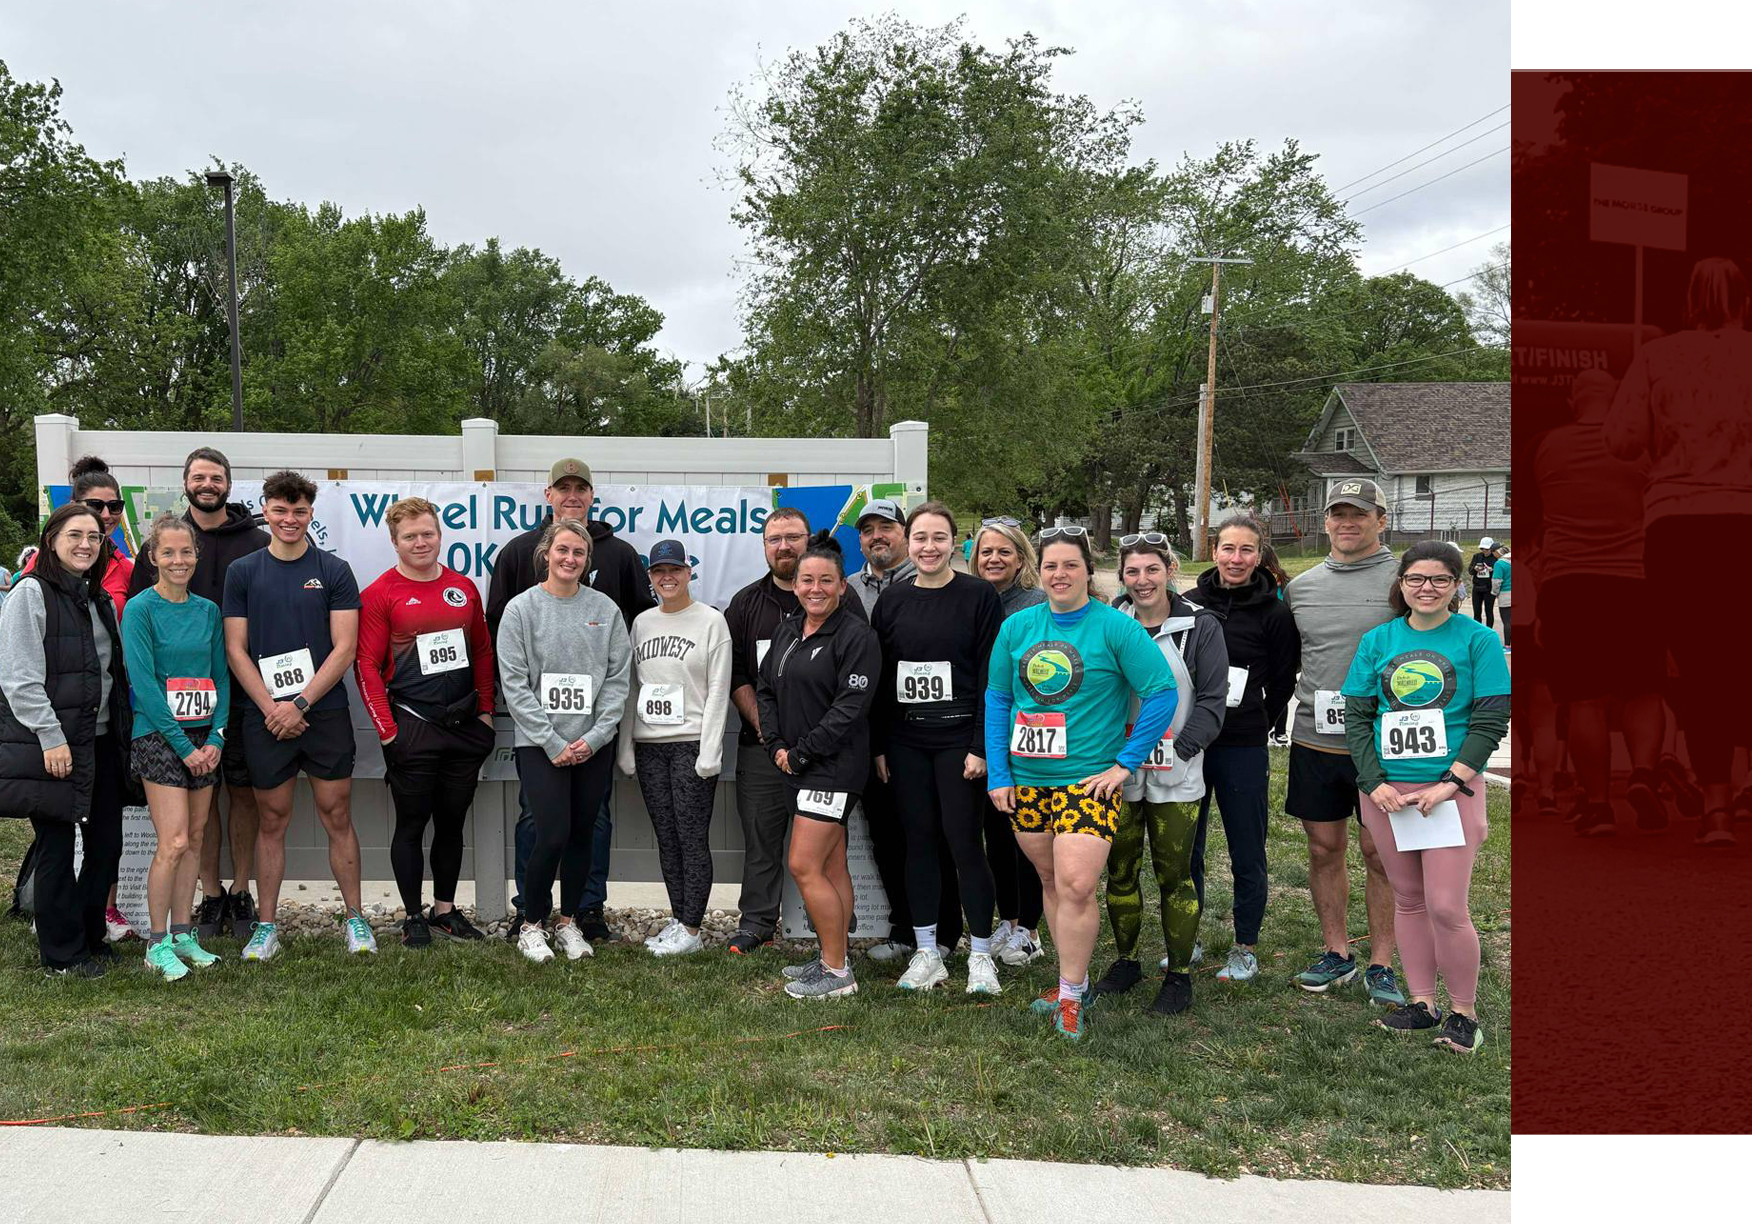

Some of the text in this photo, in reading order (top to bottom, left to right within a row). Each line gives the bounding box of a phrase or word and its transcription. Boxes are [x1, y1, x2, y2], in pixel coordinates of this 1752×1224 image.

[1650, 205, 1683, 216] GROUP
[1512, 346, 1608, 369] T/FINISH
[350, 493, 477, 530] Wel
[493, 495, 552, 531] Ru
[656, 499, 769, 534] Meals
[429, 646, 457, 664] 895
[635, 635, 695, 665] MIDWEST
[273, 668, 304, 688] 888
[849, 674, 868, 688] 80
[905, 676, 943, 700] 939
[175, 691, 211, 716] 2794
[549, 687, 585, 710] 935
[646, 700, 672, 715] 898
[1326, 708, 1345, 725] 85
[1017, 726, 1056, 753] 2817
[1389, 726, 1436, 755] 943
